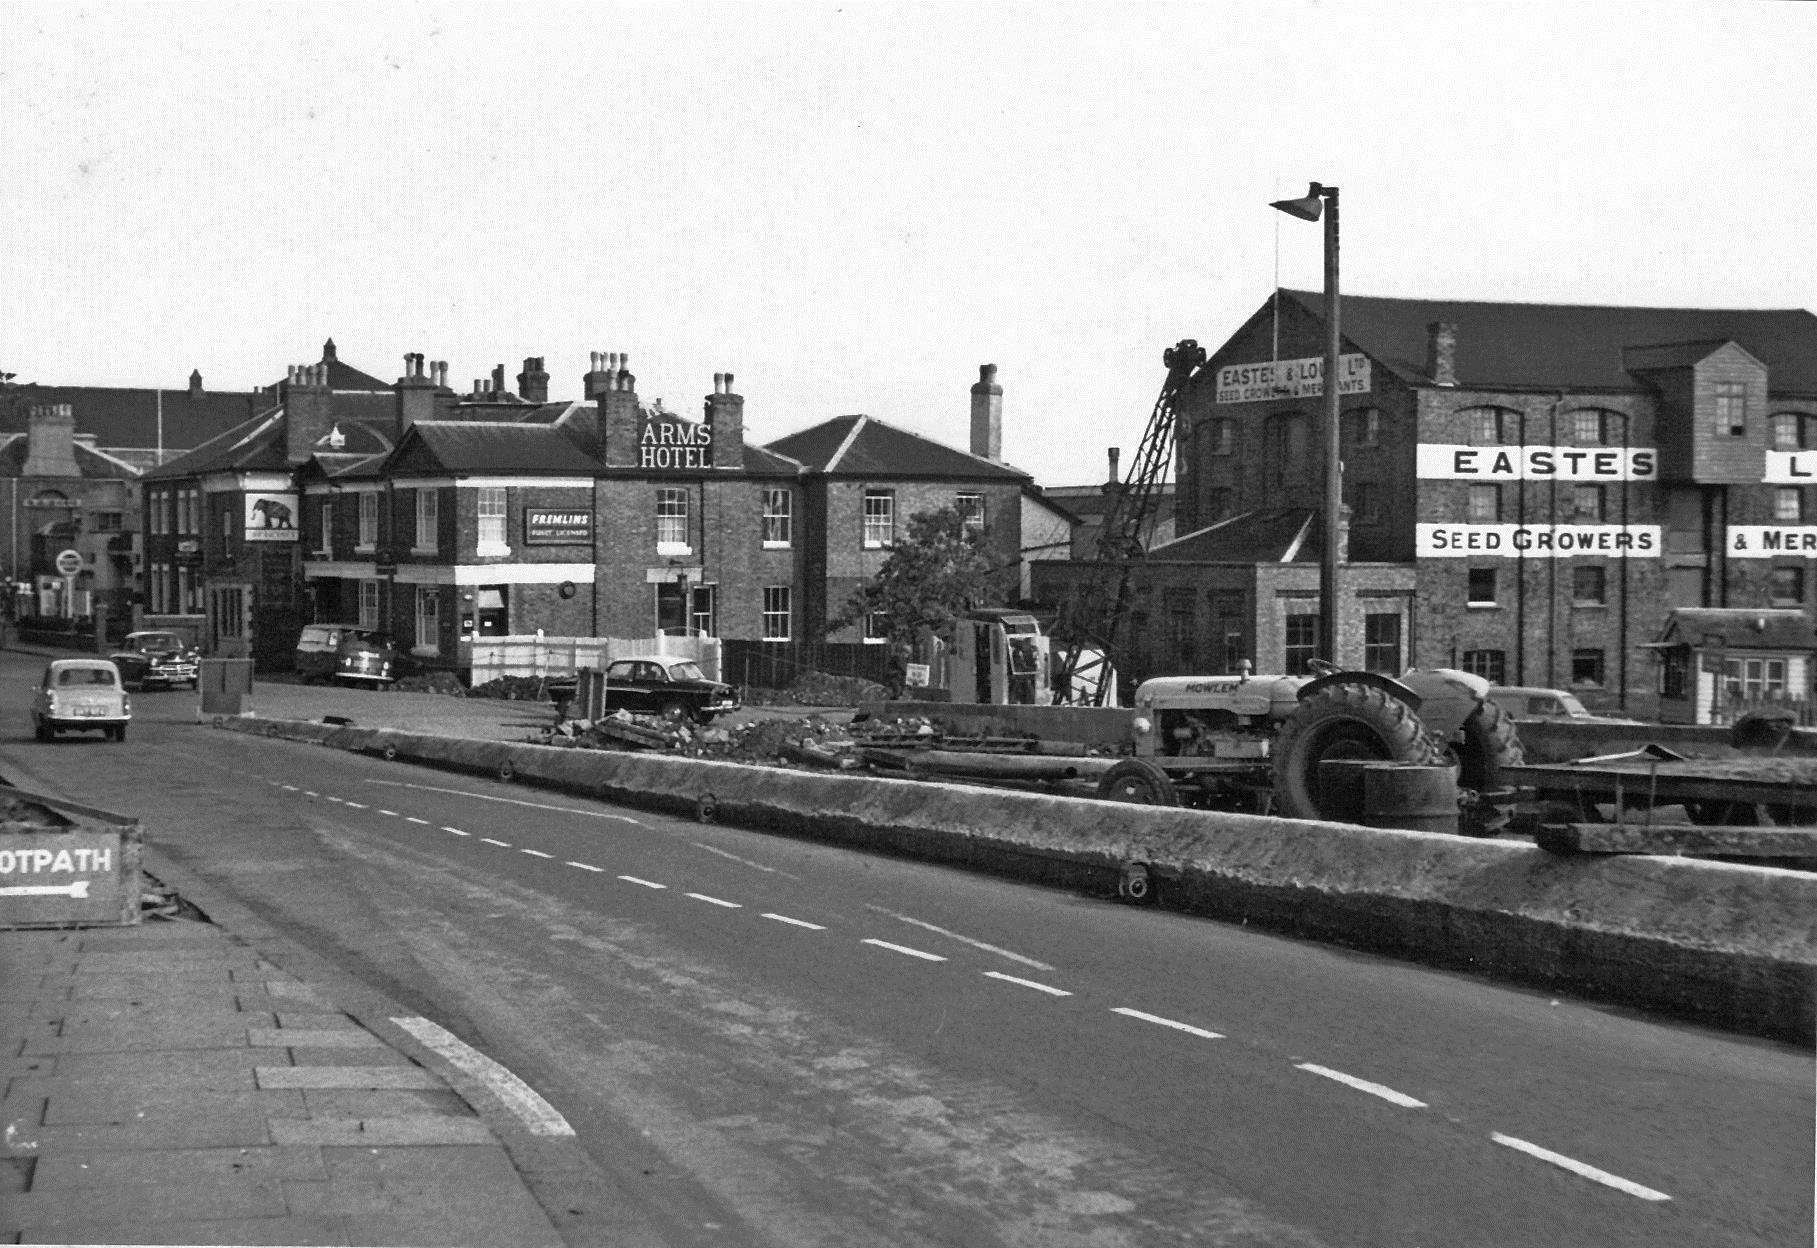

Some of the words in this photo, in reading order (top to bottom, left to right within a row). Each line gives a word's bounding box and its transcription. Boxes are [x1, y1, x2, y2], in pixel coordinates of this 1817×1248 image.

[641, 423, 711, 446] ARMS
[641, 446, 711, 468] HOTEL
[1454, 451, 1653, 476] EASTES
[532, 514, 588, 525] FREMLINS
[1432, 529, 1501, 550] SEED
[1513, 529, 1653, 551] GROWERS
[1734, 533, 1747, 550] &
[1763, 531, 1817, 550] MER
[1186, 683, 1239, 693] MOWLEM
